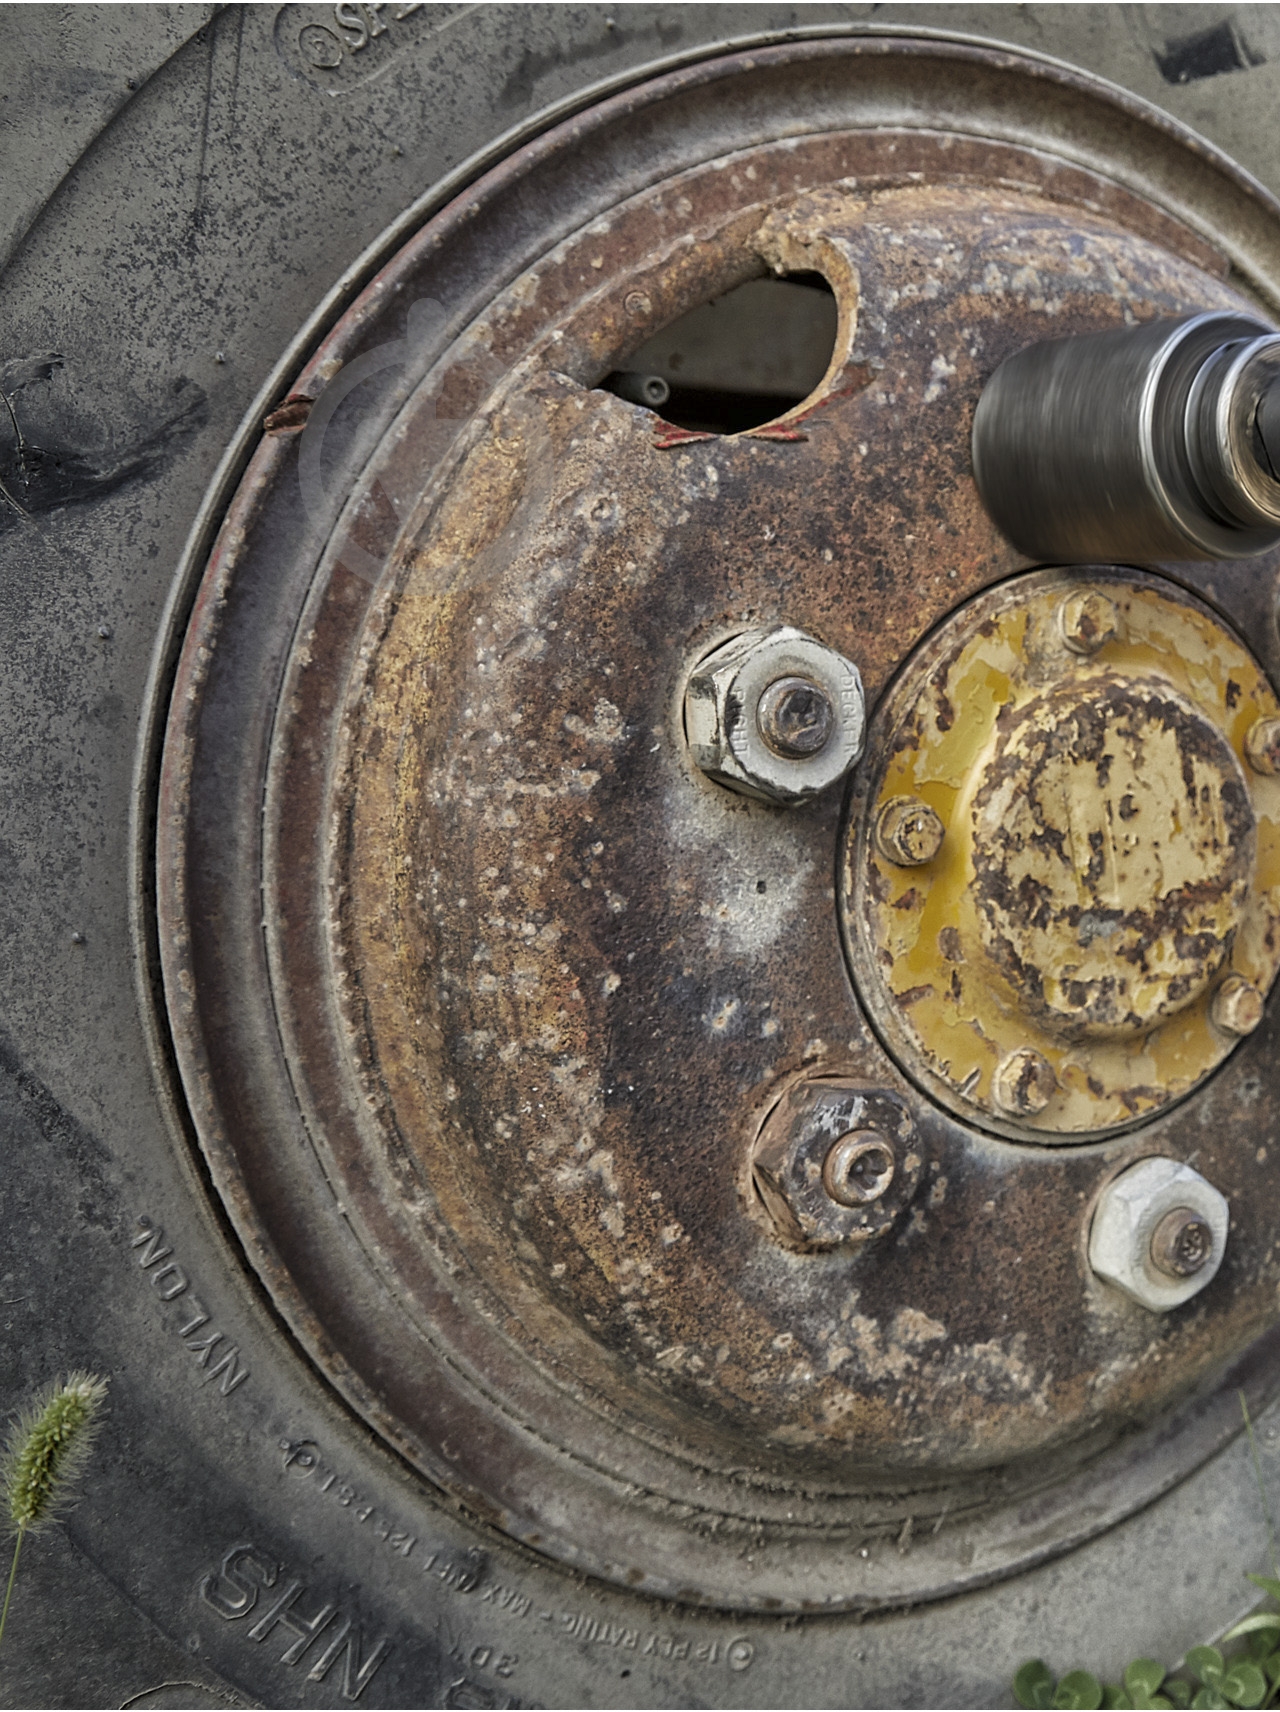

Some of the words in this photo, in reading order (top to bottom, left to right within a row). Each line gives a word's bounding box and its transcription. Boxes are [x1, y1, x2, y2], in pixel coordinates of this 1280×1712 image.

[131, 1225, 249, 1396] NYLON
[201, 1544, 393, 1701] NHS
[562, 1612, 640, 1650] RATING
